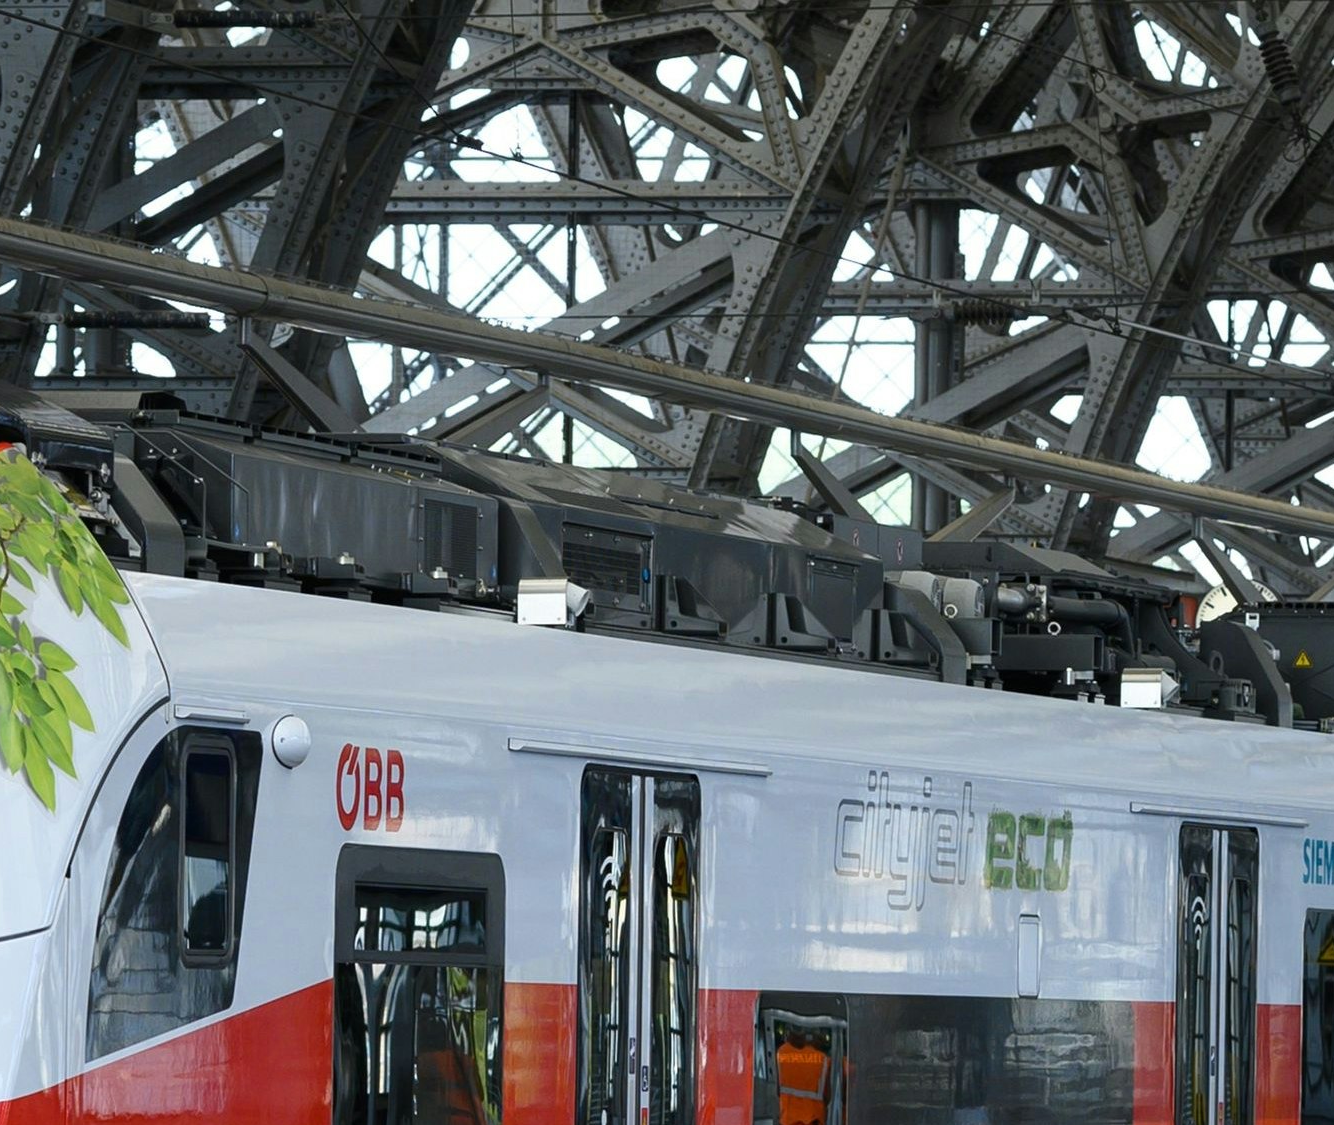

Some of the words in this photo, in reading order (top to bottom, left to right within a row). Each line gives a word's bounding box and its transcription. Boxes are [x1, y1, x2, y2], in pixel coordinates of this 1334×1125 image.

[336, 743, 406, 833] ÖBB
[834, 770, 975, 911] cityjet
[984, 806, 1074, 892] eco
